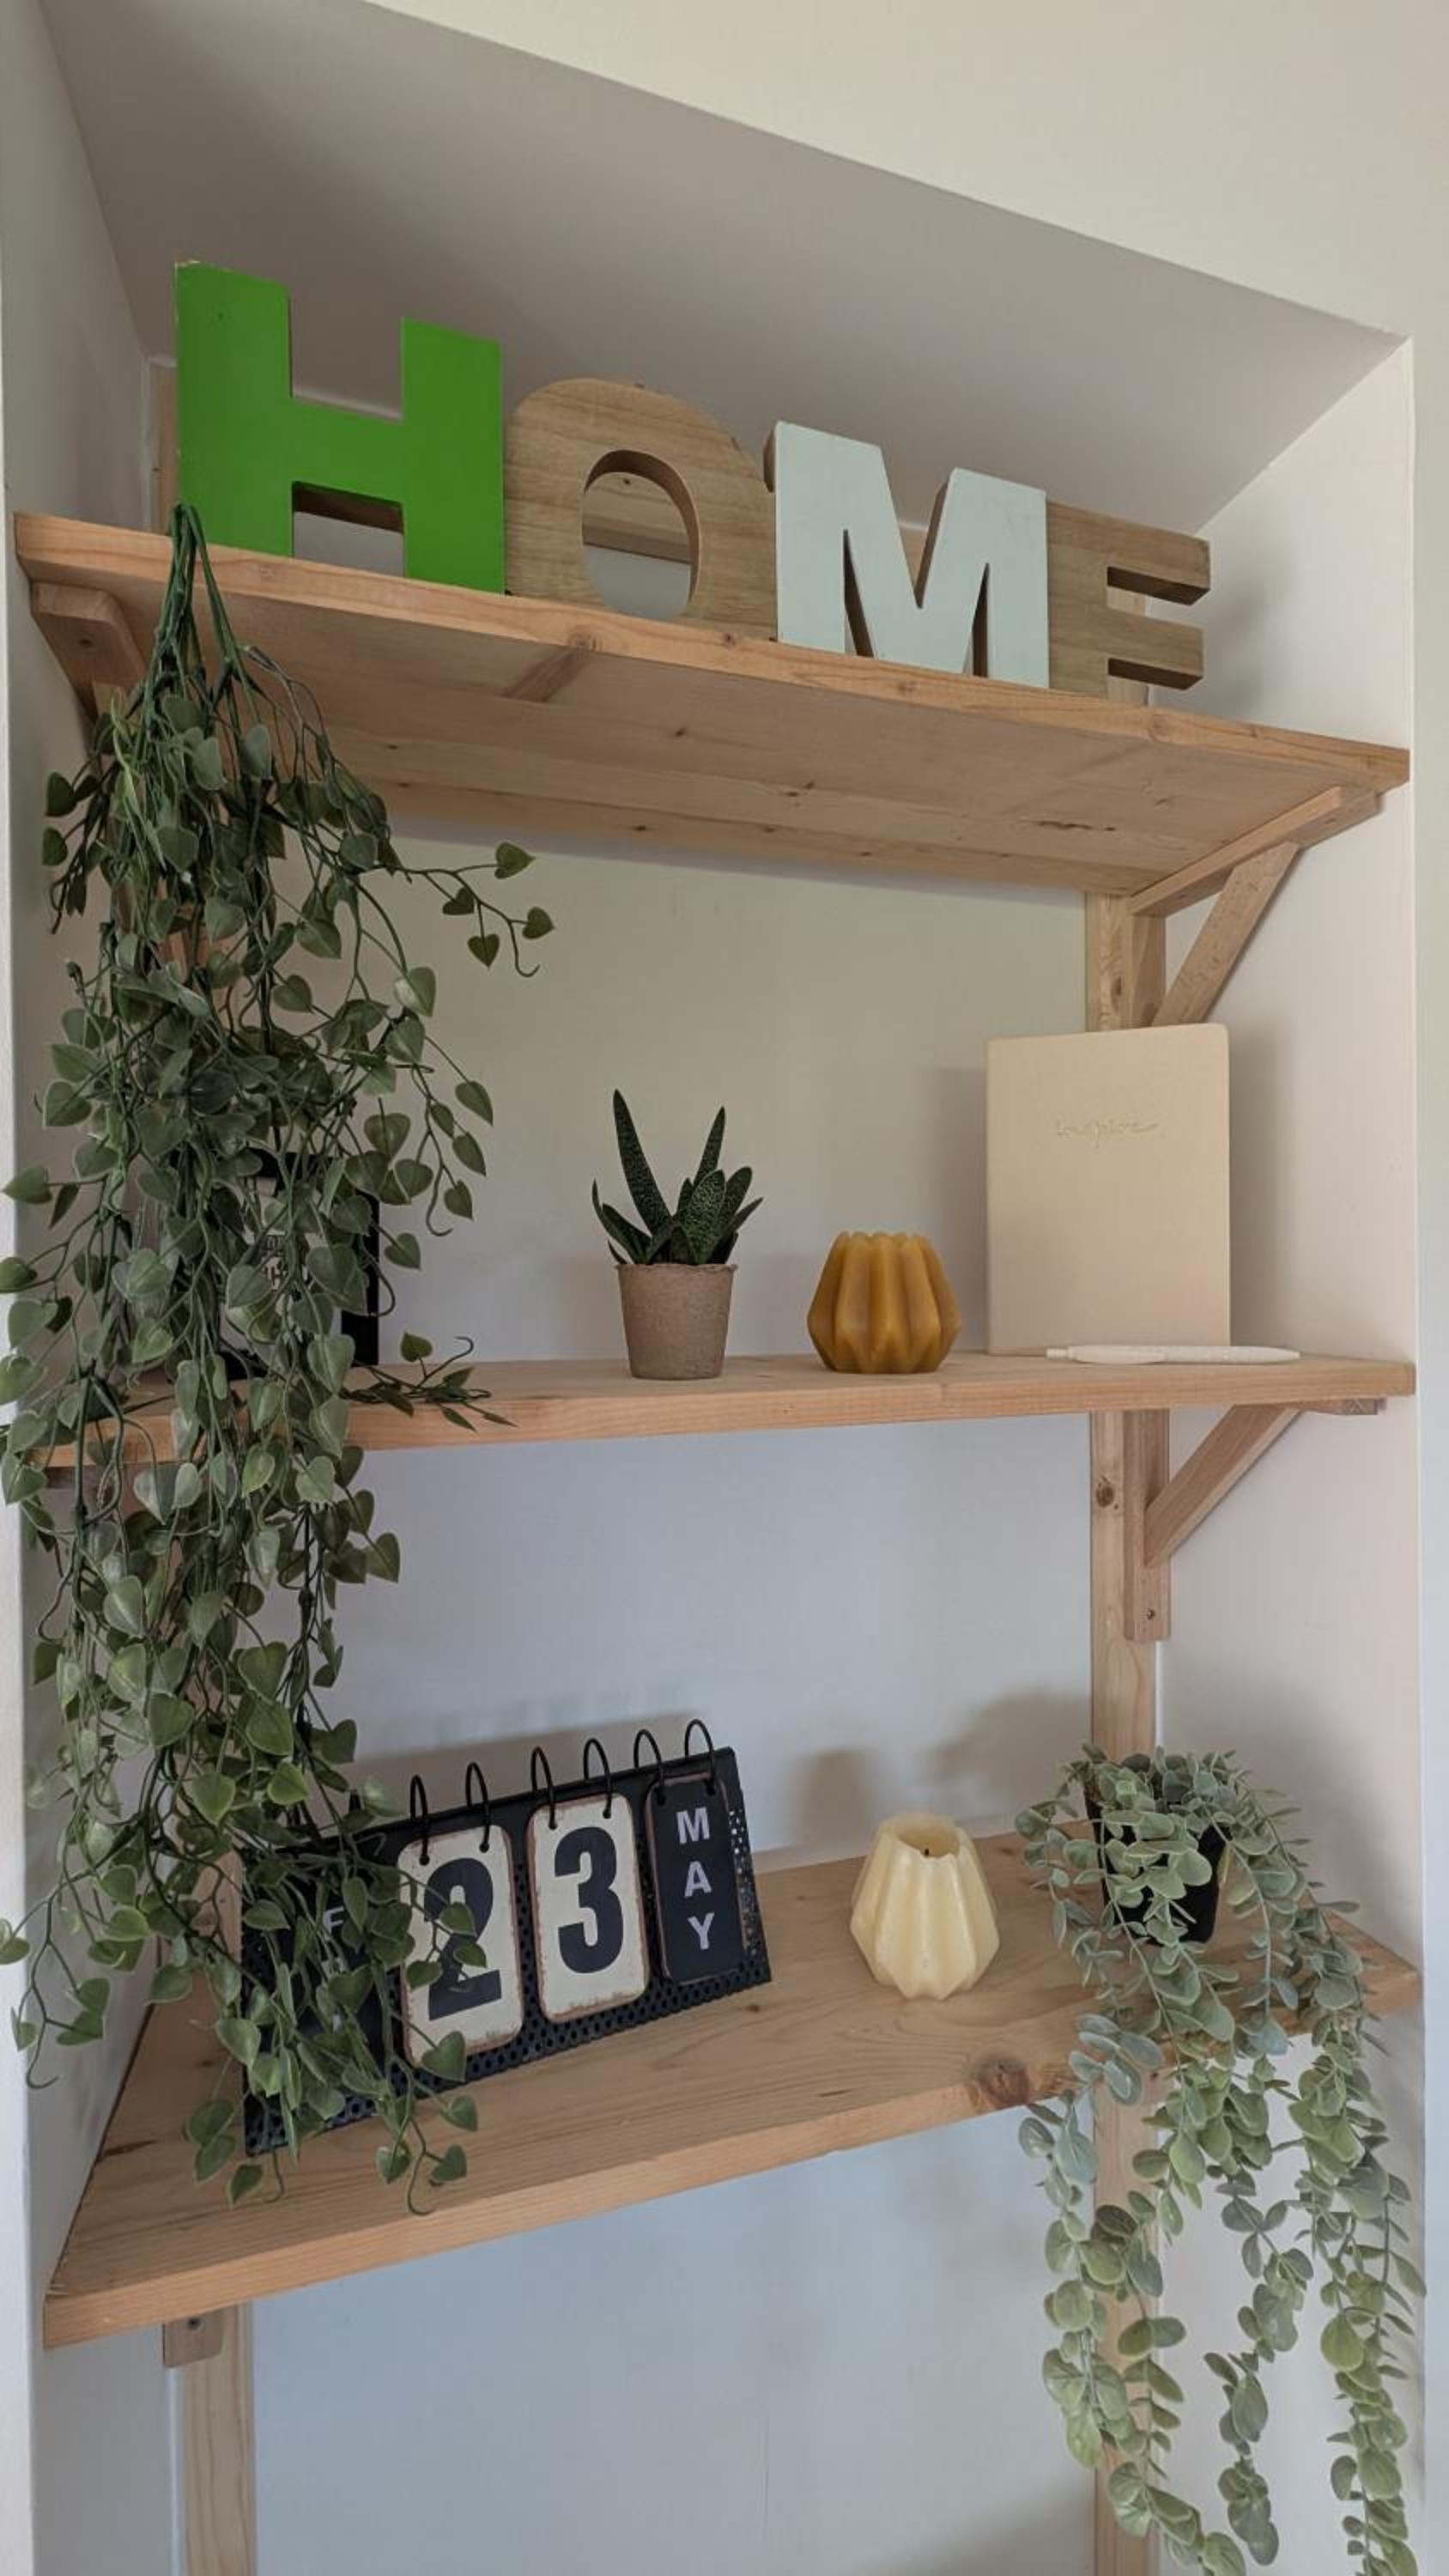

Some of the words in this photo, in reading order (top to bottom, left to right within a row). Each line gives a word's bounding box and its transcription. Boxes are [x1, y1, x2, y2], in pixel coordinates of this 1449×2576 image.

[175, 260, 1211, 700] HOME
[424, 1826, 624, 2021] 23
[676, 1806, 715, 1950] MAY
